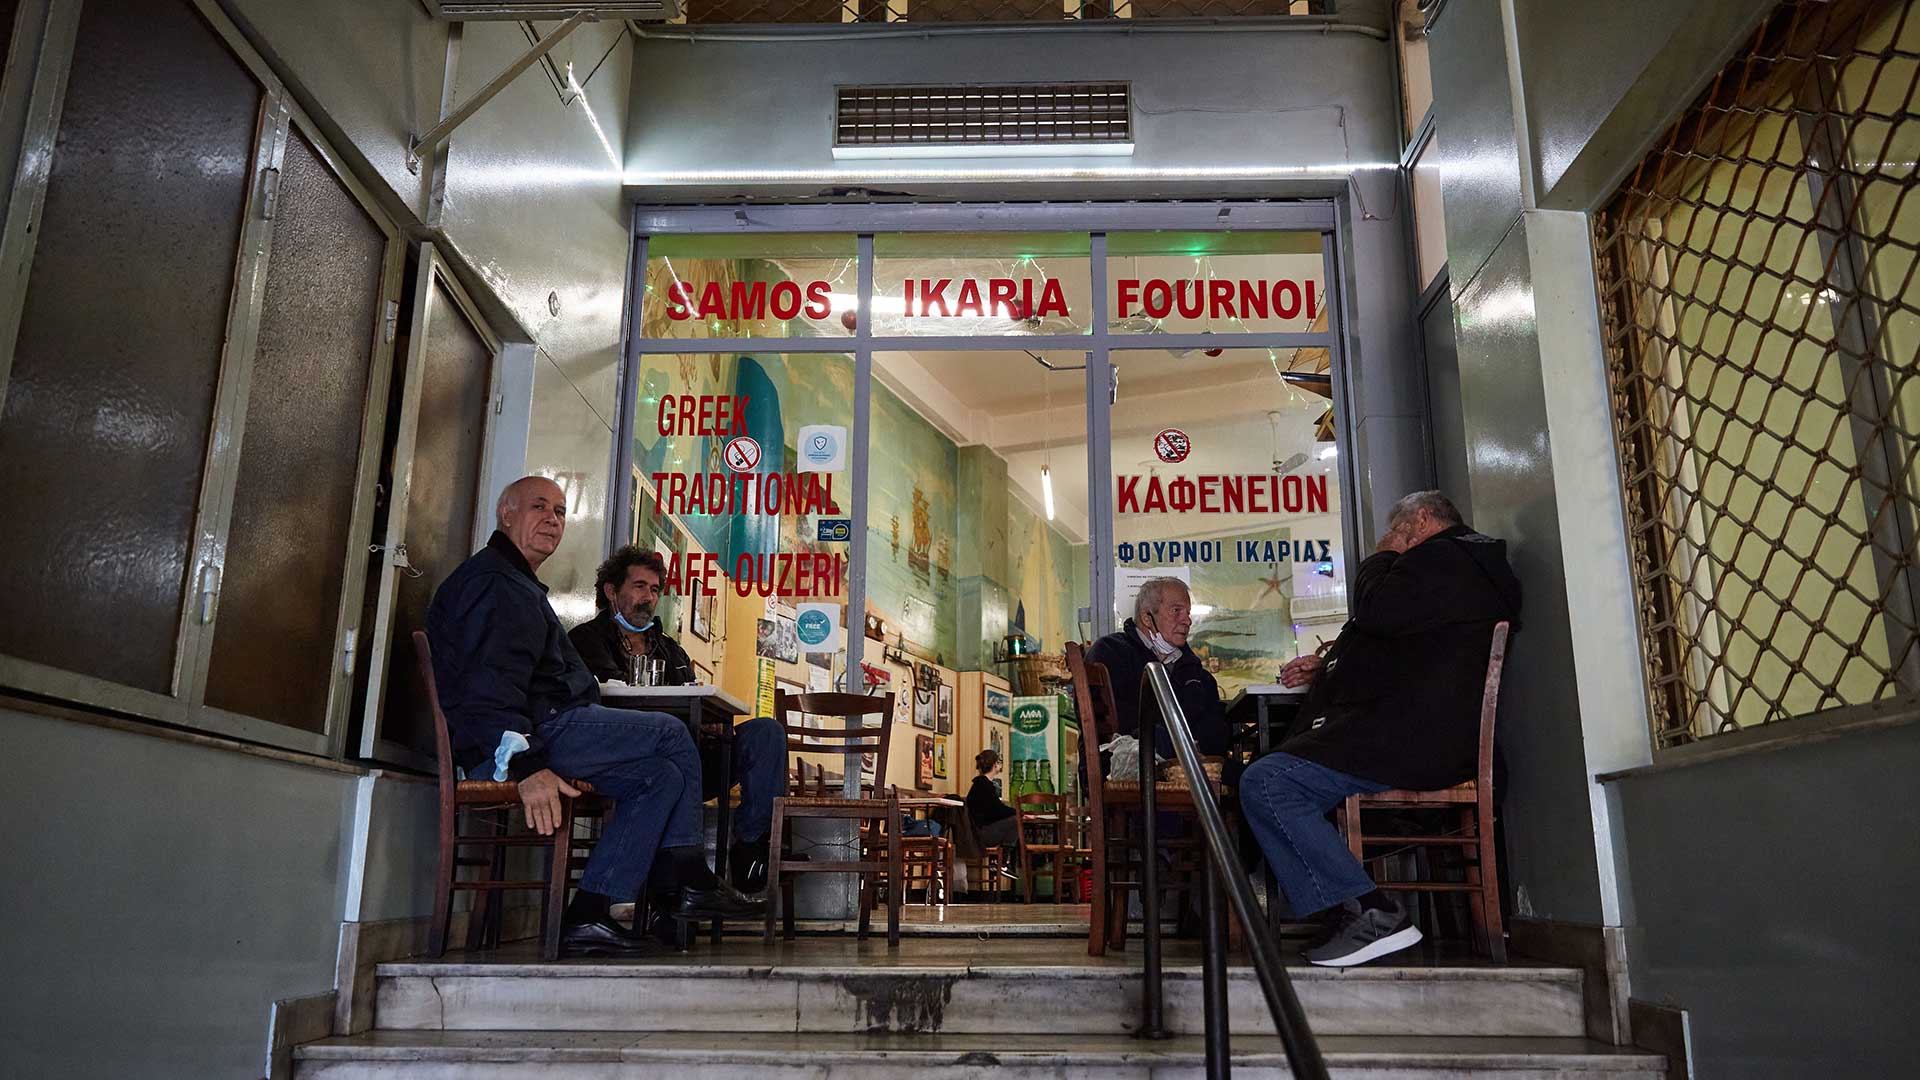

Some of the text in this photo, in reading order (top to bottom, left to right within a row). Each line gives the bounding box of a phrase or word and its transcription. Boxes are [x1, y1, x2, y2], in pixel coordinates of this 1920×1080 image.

[666, 278, 1317, 321] SAMOS IKARIA FOURNOI
[657, 394, 750, 437] GREEK
[651, 472, 840, 516] TRADITIONAL
[1117, 475, 1328, 514] ΚΑΦΕΝΕΙΟΝ
[1118, 540, 1333, 563] ΦΟΥΡΝΟΙ ΙΚΑΡΙΑΣ
